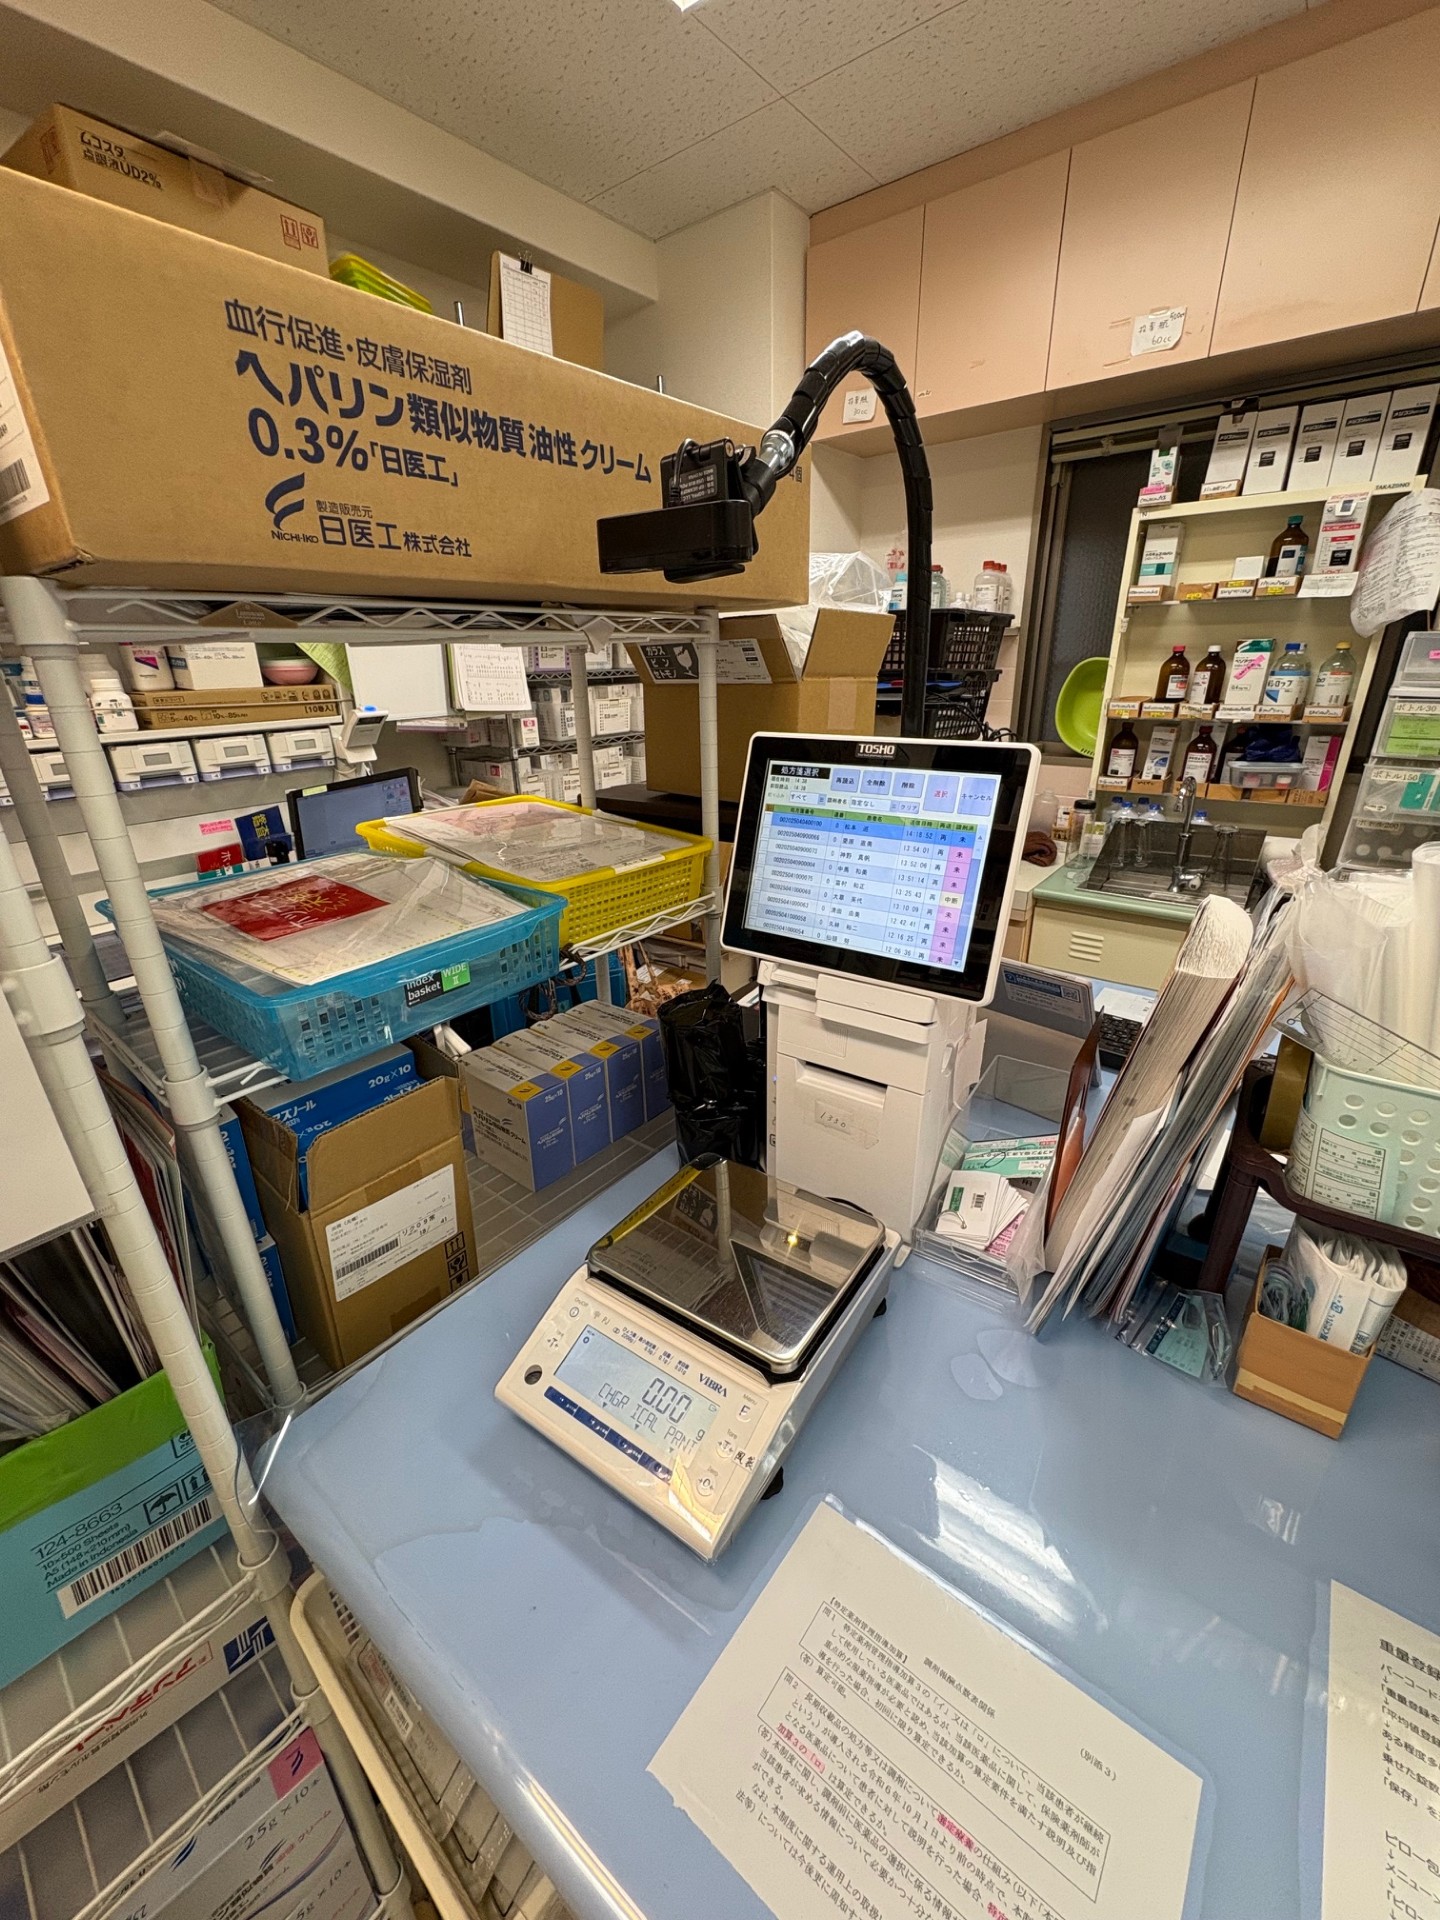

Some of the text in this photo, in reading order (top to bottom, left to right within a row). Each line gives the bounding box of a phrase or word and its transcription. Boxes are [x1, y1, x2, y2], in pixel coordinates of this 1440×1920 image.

[224, 299, 473, 396] 血行促進・皮膚保湿剤
[248, 408, 459, 487] 0.3%「日医工」
[315, 500, 373, 518] 製造販売元
[645, 646, 666, 656] ガラス
[653, 669, 677, 679] セトモノ
[859, 744, 895, 754] TOSHO
[961, 793, 992, 801] キャンセル
[442, 961, 467, 977] WIDE
[408, 982, 441, 1001] basket
[368, 1064, 411, 1089] 20g×10
[641, 1377, 706, 1442] 0.00 g
[664, 1426, 698, 1456] PRNT
[36, 1502, 122, 1560] 124-8663
[83, 1522, 120, 1546] Sheets
[46, 1528, 138, 1588] Made in Indonesia
[830, 1597, 908, 1664] 【特定薬剤管理指導加算】
[923, 1656, 996, 1720] 調剤報酬点数表関係
[1381, 1663, 1440, 1701] バーコード
[1382, 1729, 1440, 1771] ある程度多
